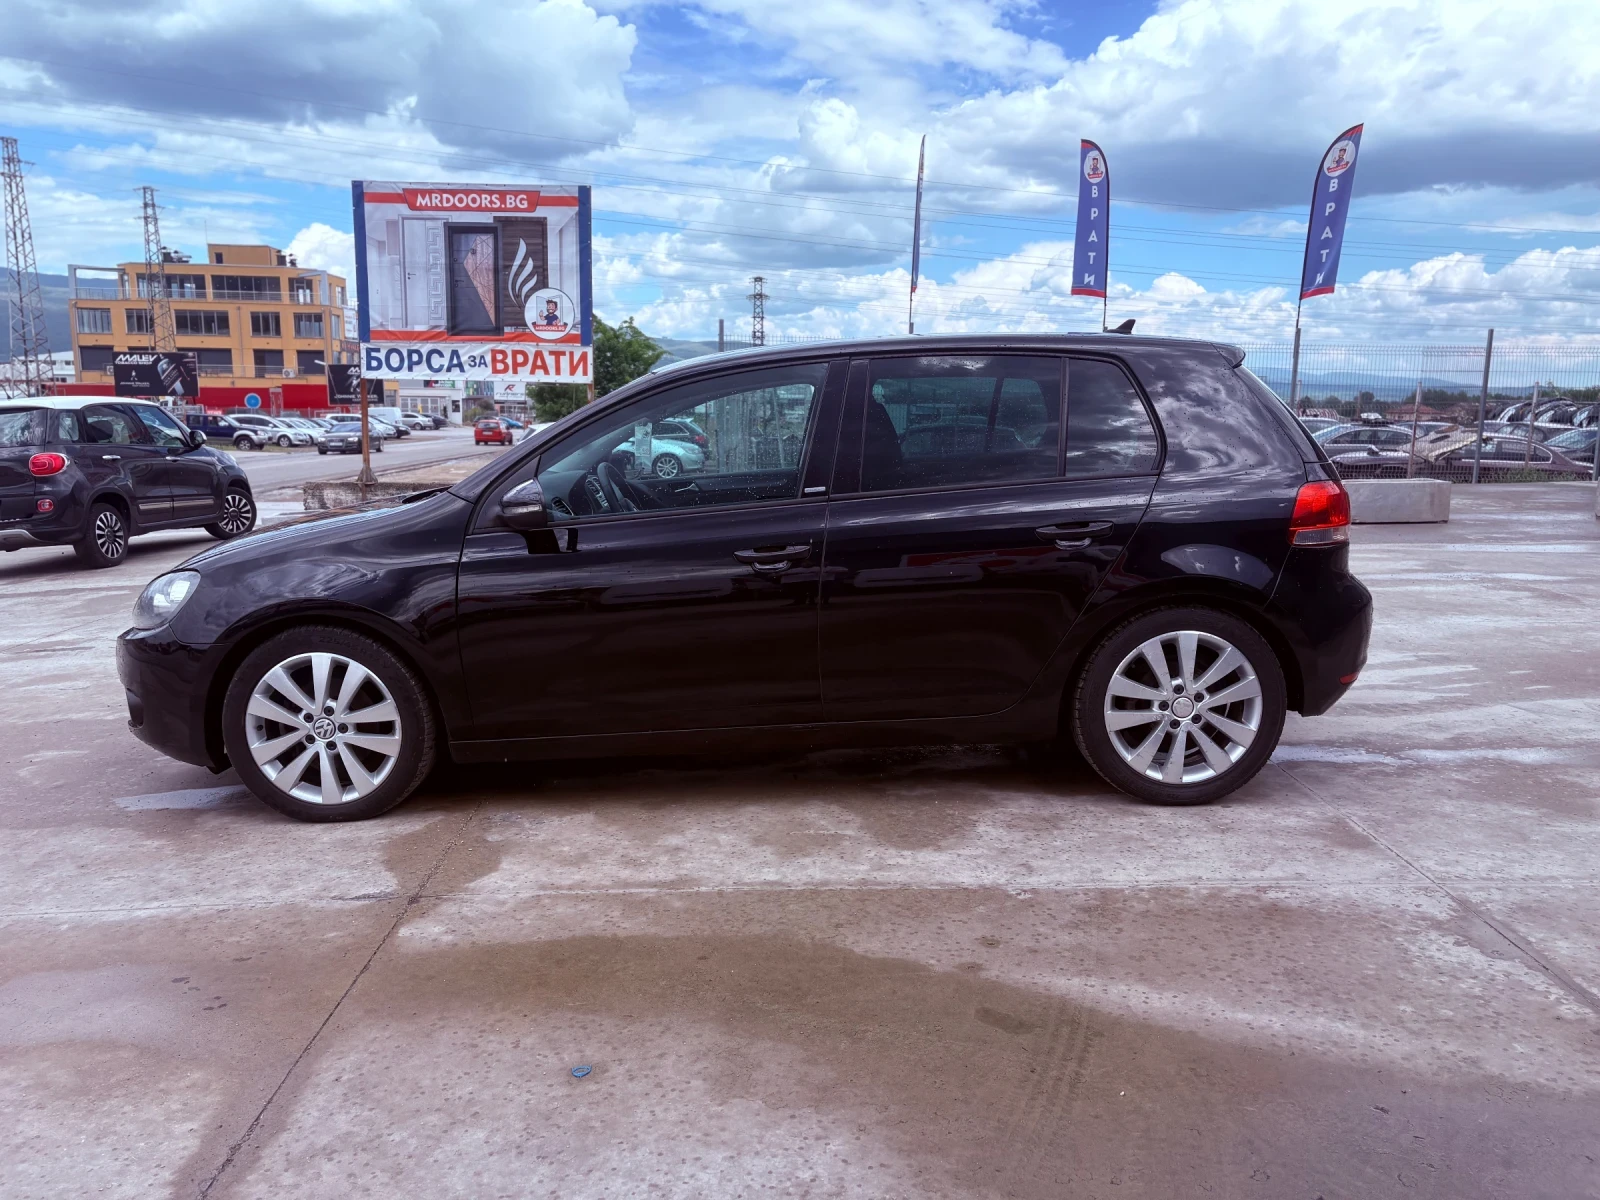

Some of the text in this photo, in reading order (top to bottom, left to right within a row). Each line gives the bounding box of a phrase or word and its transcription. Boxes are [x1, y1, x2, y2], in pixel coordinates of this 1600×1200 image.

[415, 192, 528, 209] MRDOORS.BG
[1315, 178, 1340, 286] ВРАТИ
[1083, 185, 1099, 286] ВРАТИ
[365, 347, 465, 374] БОРСА
[490, 348, 589, 377] ВРАТИ
